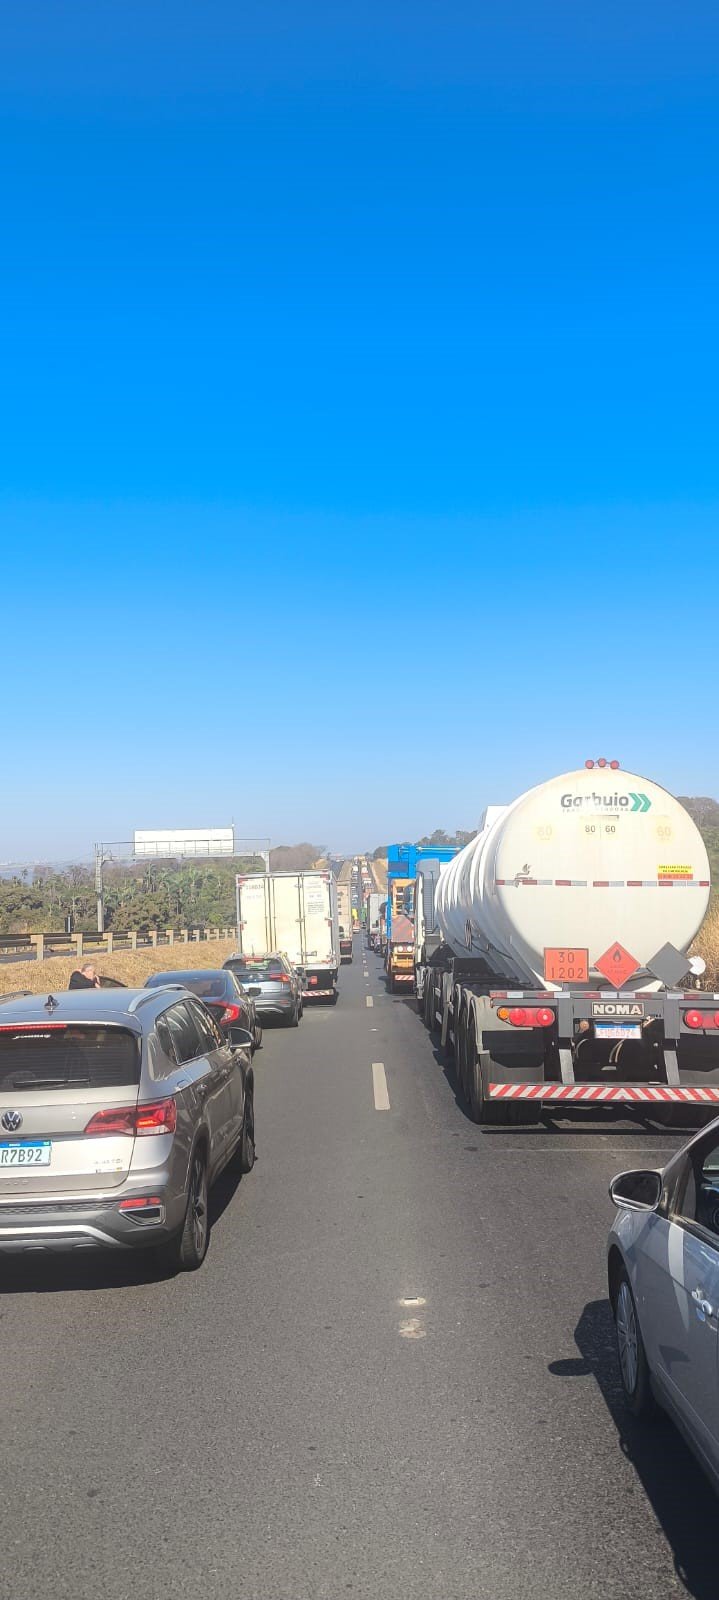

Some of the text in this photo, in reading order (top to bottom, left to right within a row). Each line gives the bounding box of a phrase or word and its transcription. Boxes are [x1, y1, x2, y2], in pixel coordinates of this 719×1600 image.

[605, 825, 616, 833] 60
[558, 951, 575, 964] 30
[551, 967, 584, 979] 1202
[593, 1004, 642, 1015] NOMA
[1, 1148, 42, 1164] R7B92
